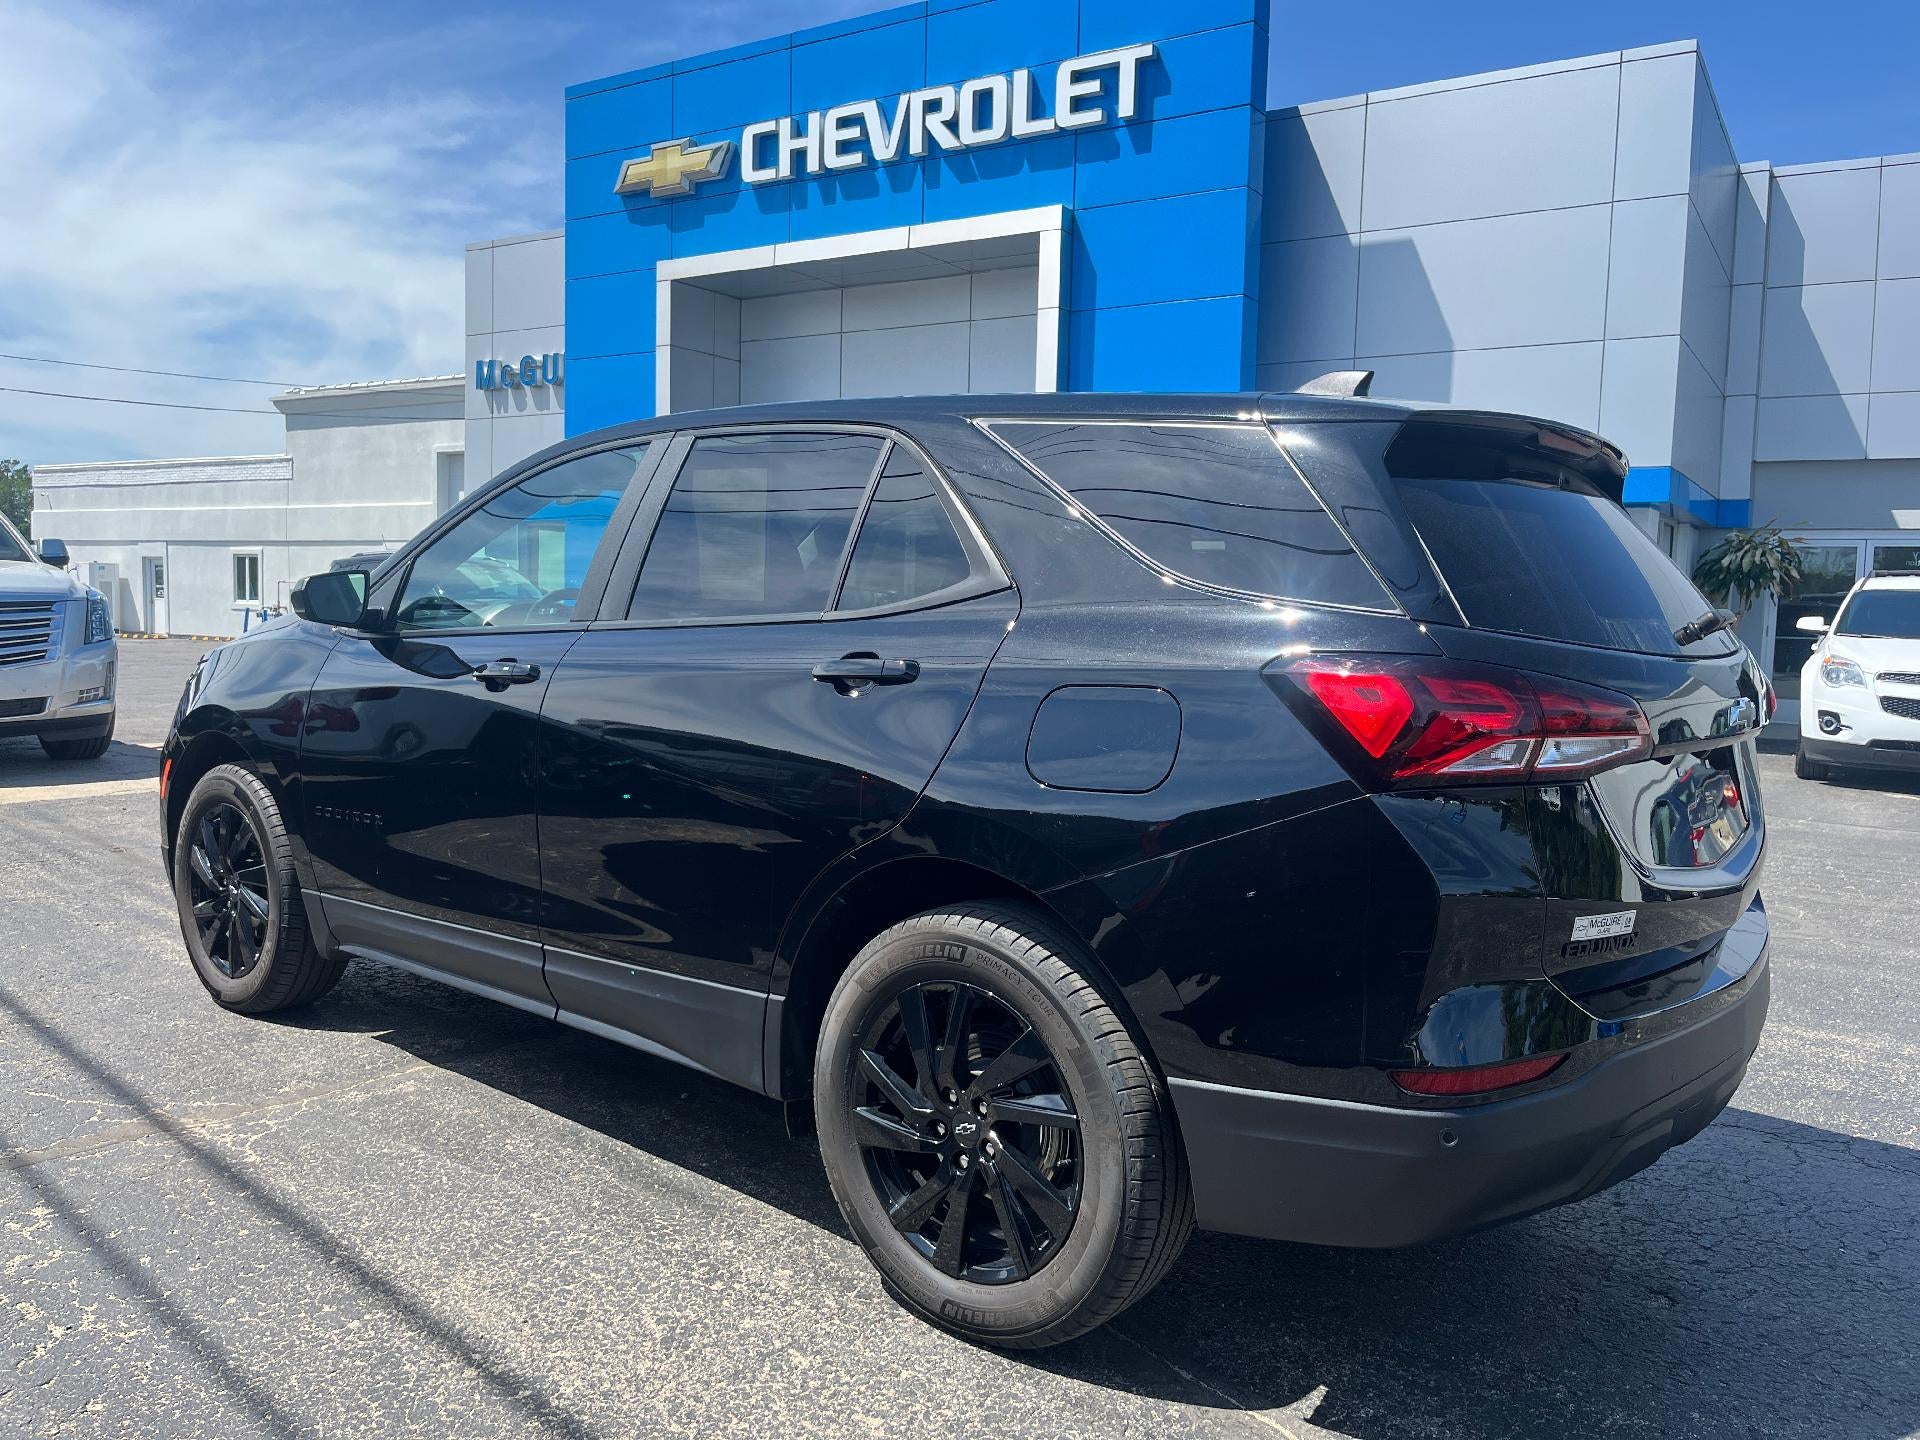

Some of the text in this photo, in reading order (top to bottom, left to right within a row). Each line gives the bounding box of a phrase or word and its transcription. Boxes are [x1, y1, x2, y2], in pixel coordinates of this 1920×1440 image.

[741, 43, 1157, 184] CHEVROLET
[476, 353, 563, 390] McGU
[1589, 916, 1623, 929] McGUIRE
[1565, 932, 1638, 958] EQUINOX
[977, 952, 1055, 1017] PRIMACY TOUR
